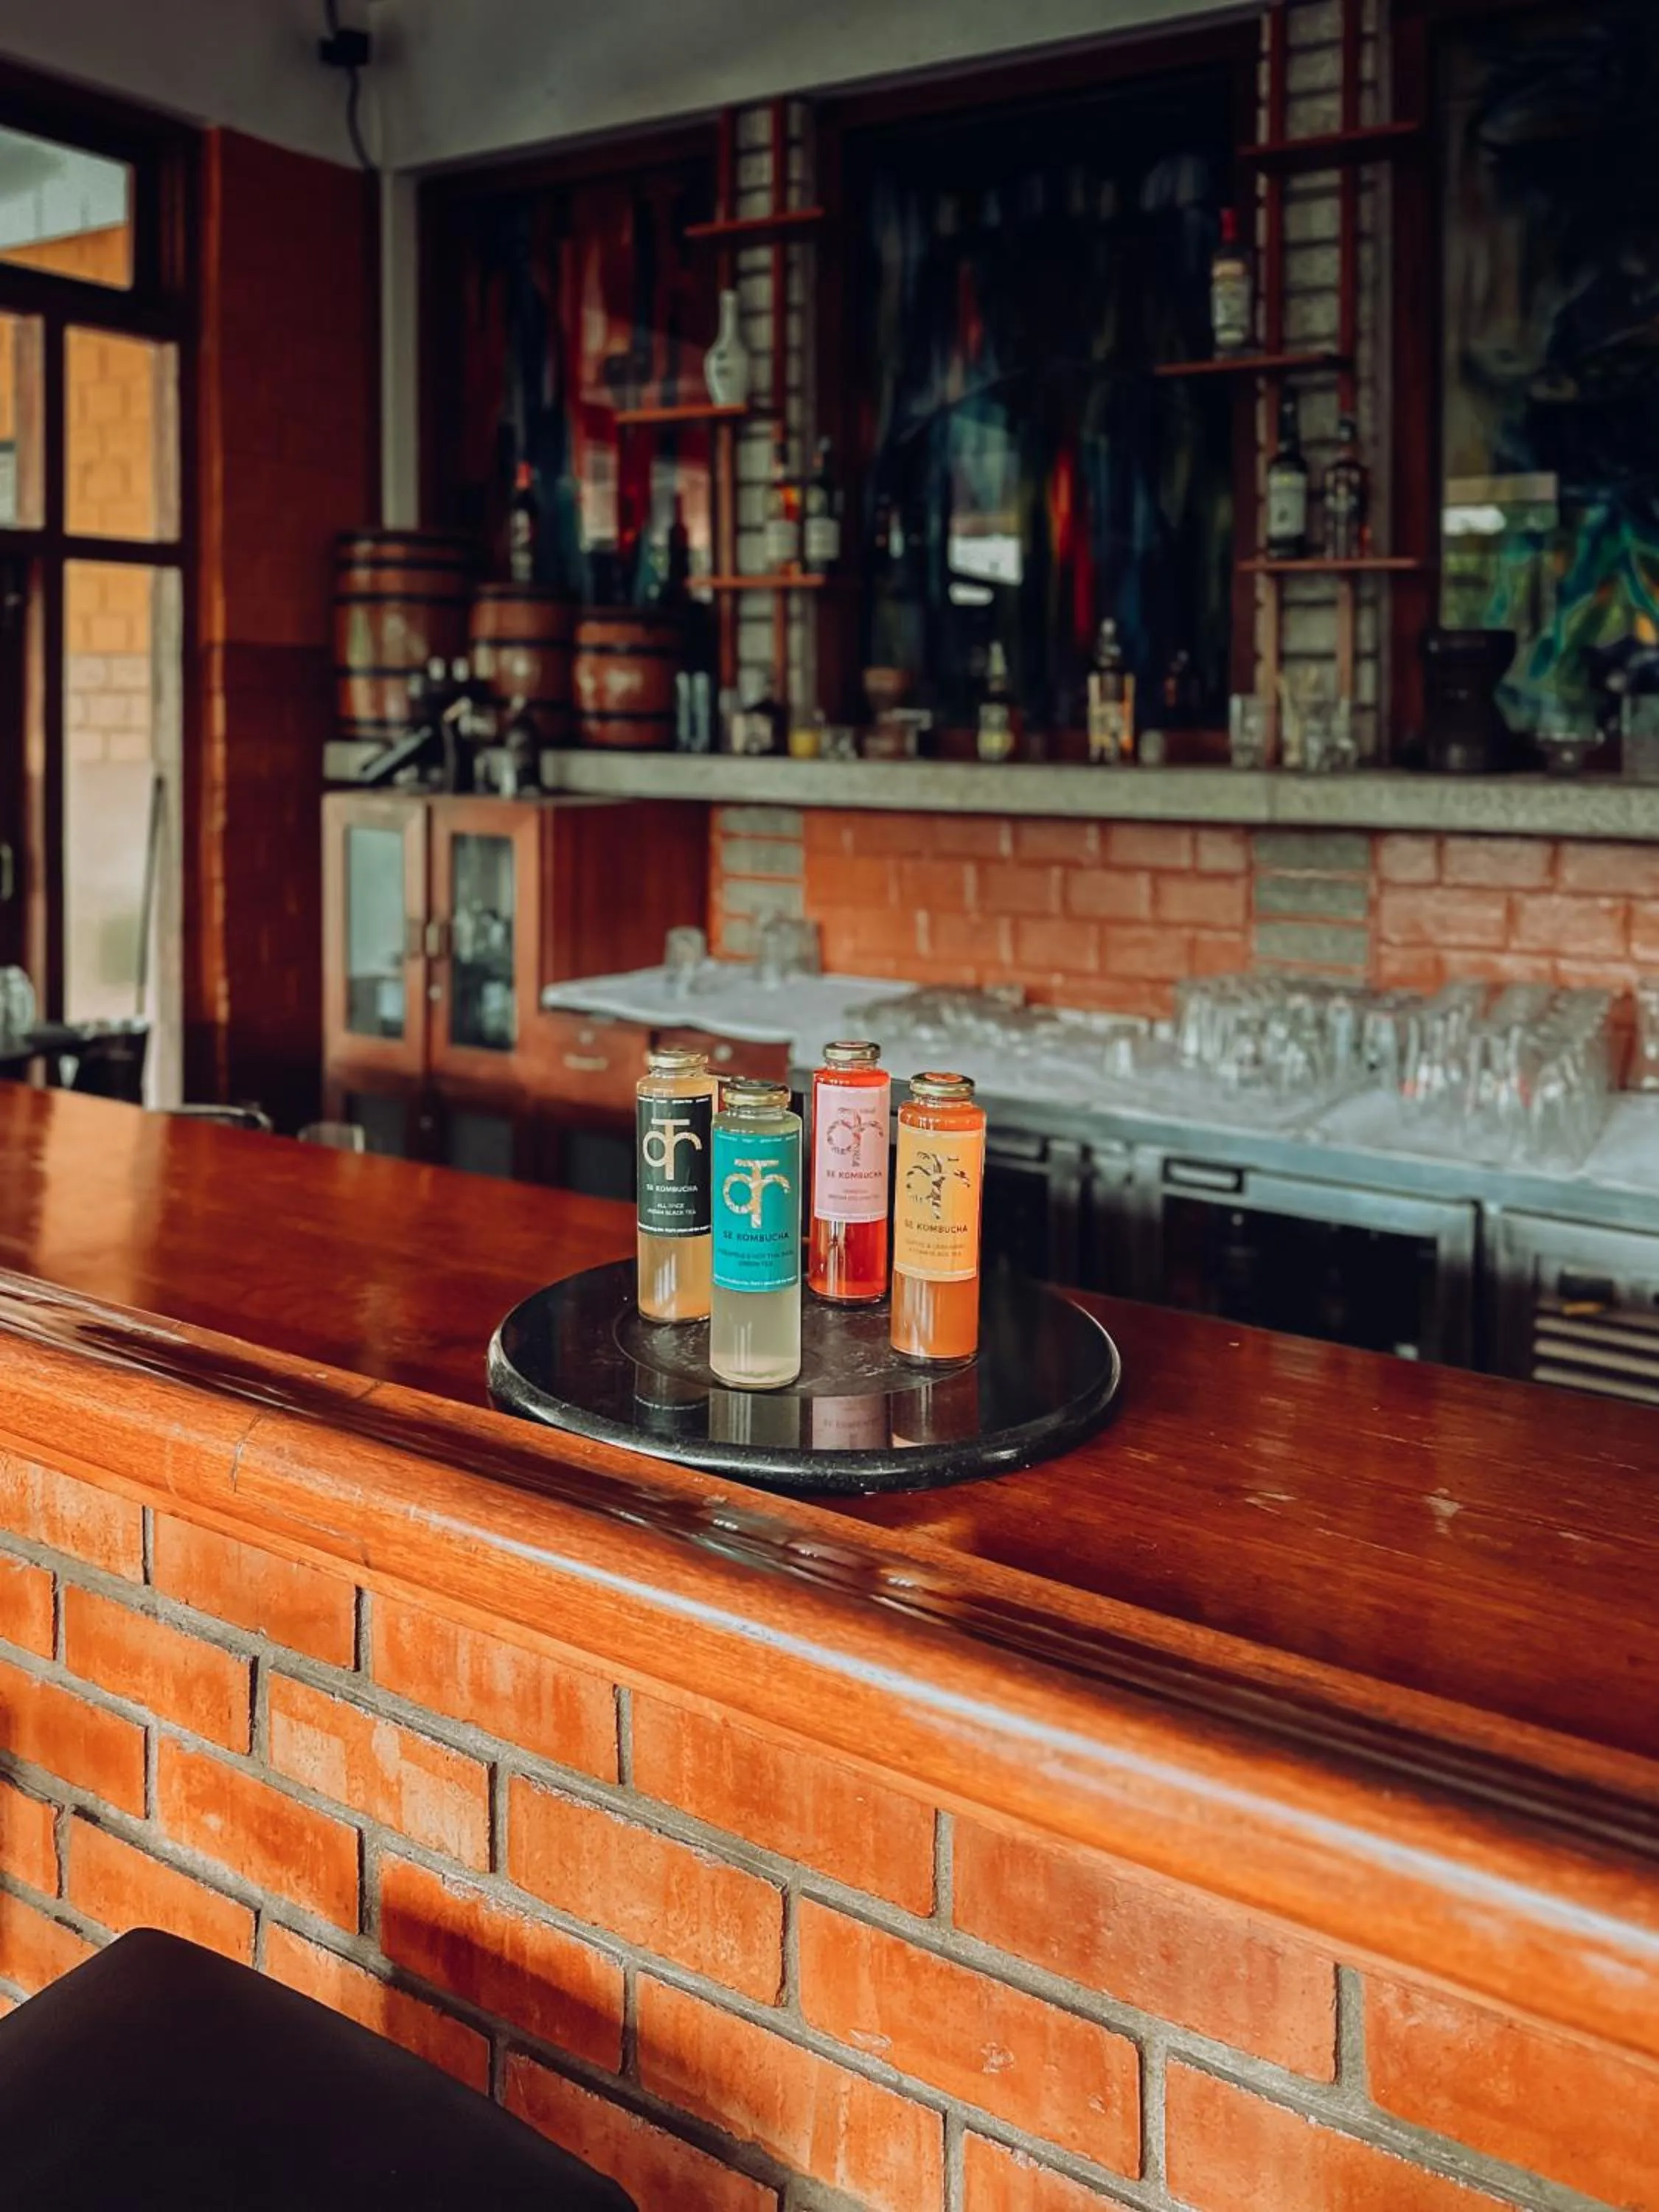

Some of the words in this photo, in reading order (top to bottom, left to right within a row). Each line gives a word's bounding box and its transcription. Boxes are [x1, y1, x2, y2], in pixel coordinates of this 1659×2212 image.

[838, 1171, 883, 1180] KOMBUCHA
[655, 1184, 699, 1193] KOMBUCHA
[916, 1222, 969, 1234] KOMBUCHA
[723, 1229, 733, 1239] SE
[736, 1231, 791, 1242] KOMBUCHA
